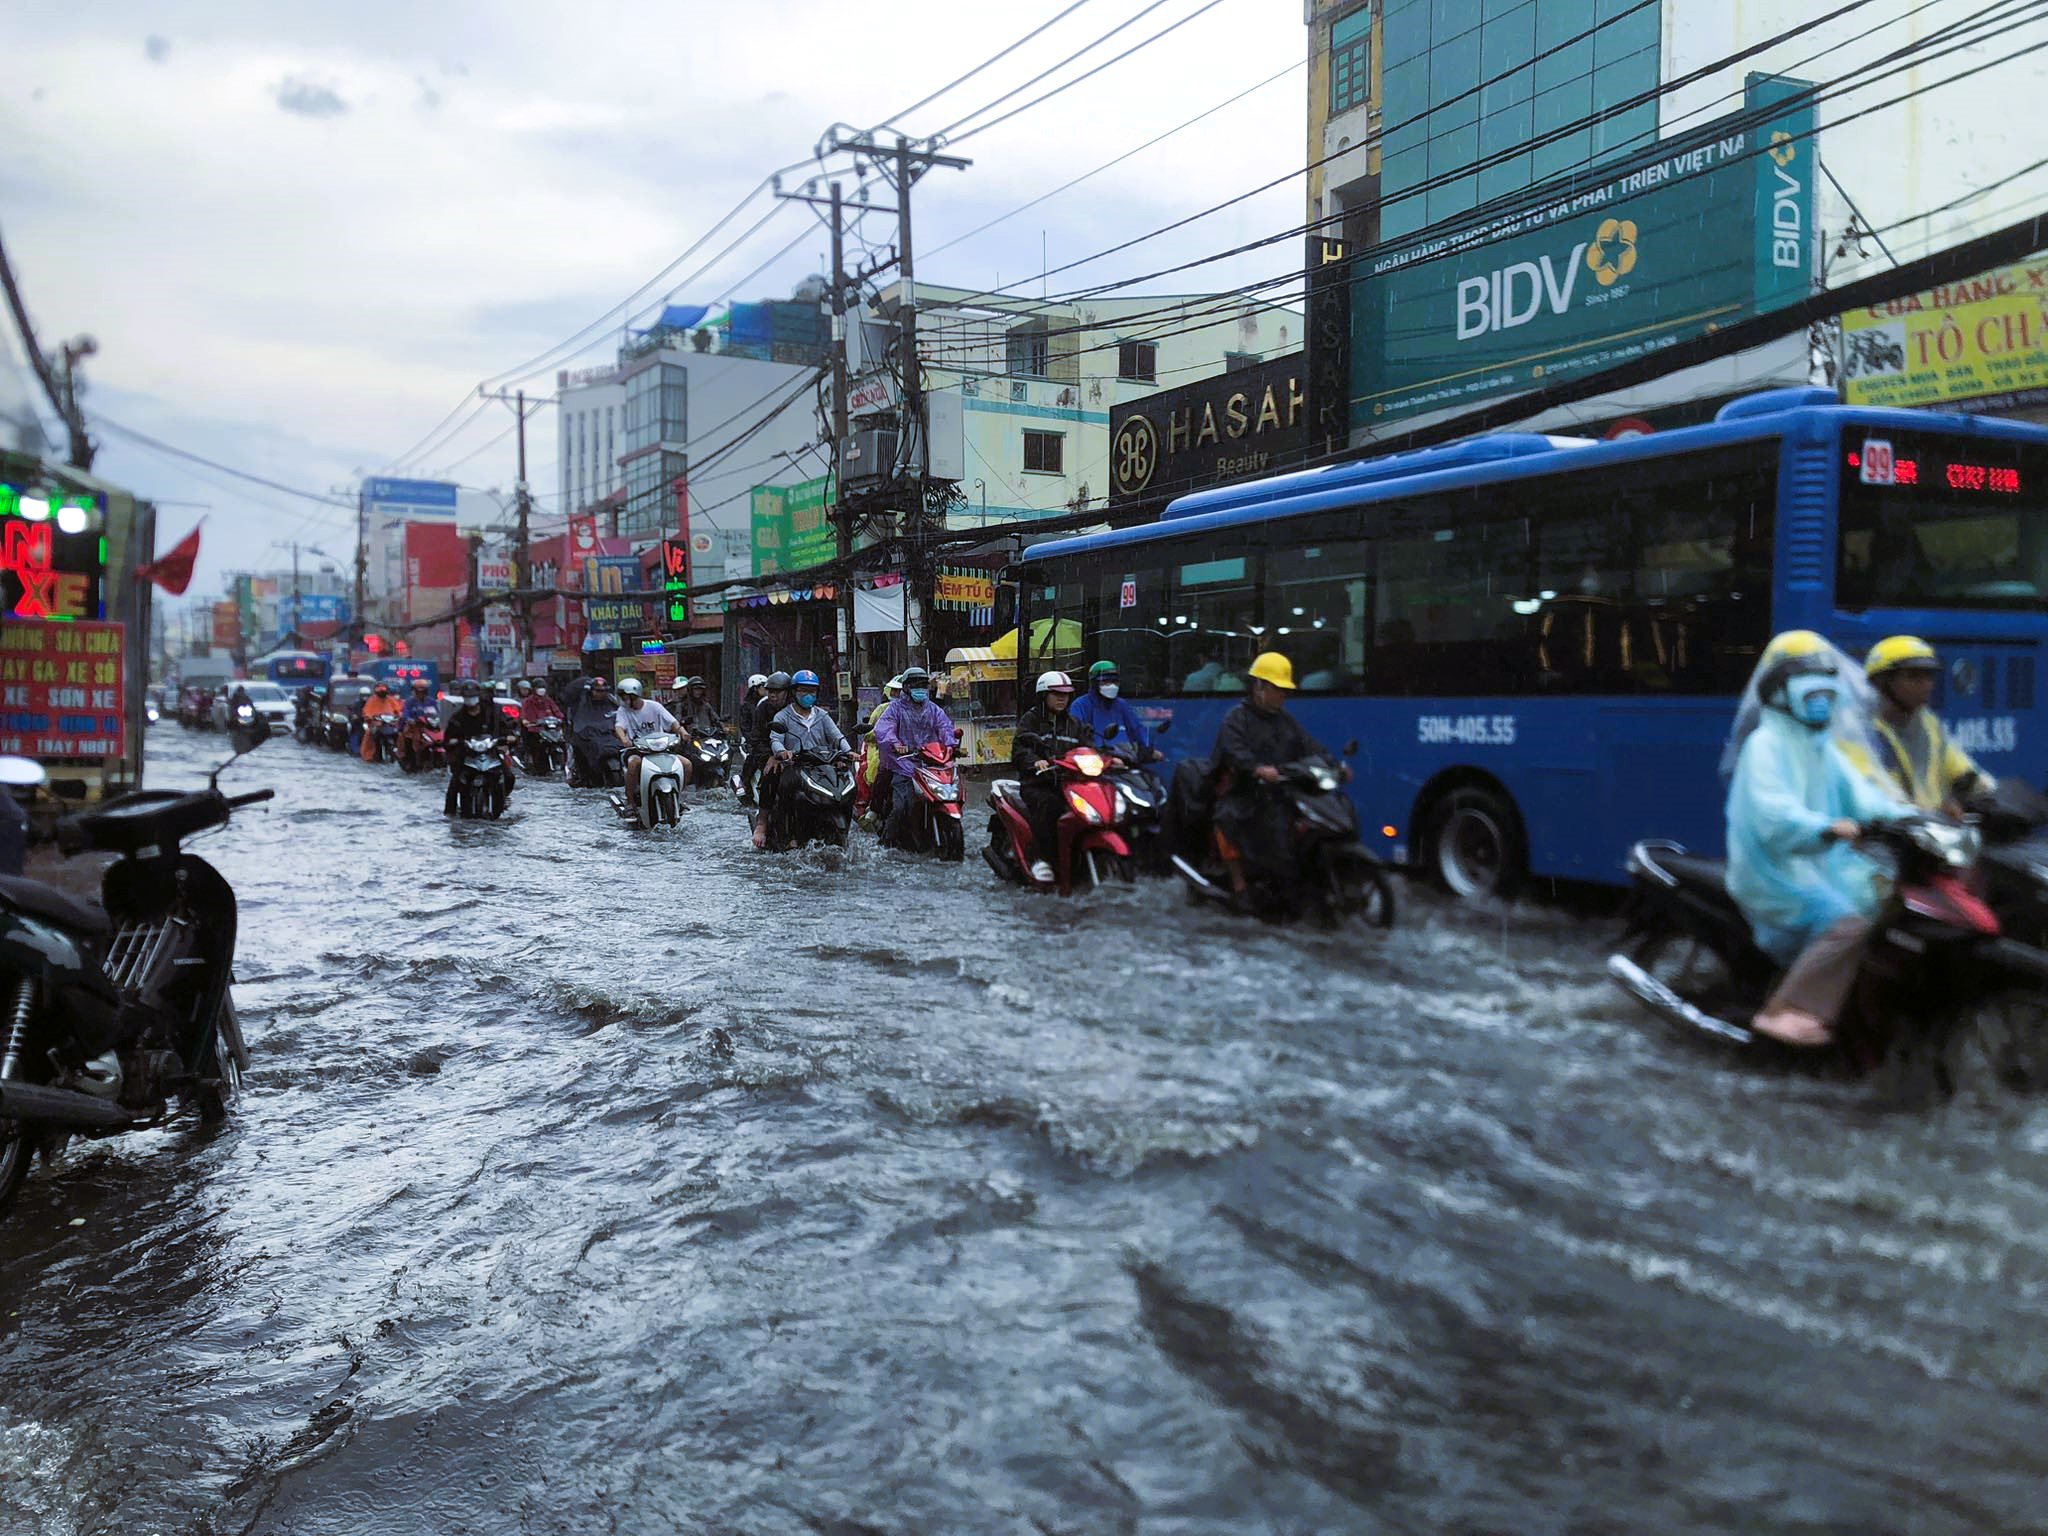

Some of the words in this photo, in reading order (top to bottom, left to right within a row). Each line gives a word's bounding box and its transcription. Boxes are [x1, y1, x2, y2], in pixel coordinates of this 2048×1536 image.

[1720, 133, 1745, 160] NA
[1773, 165, 1801, 268] BIDV
[1457, 242, 1588, 341] BIDV
[1912, 311, 1964, 367] TÔ
[1216, 451, 1269, 477] Beauty
[1866, 446, 1890, 483] 99
[14, 570, 89, 618] XE
[1123, 584, 1135, 606] 99
[1418, 715, 1516, 744] 50H-405.55
